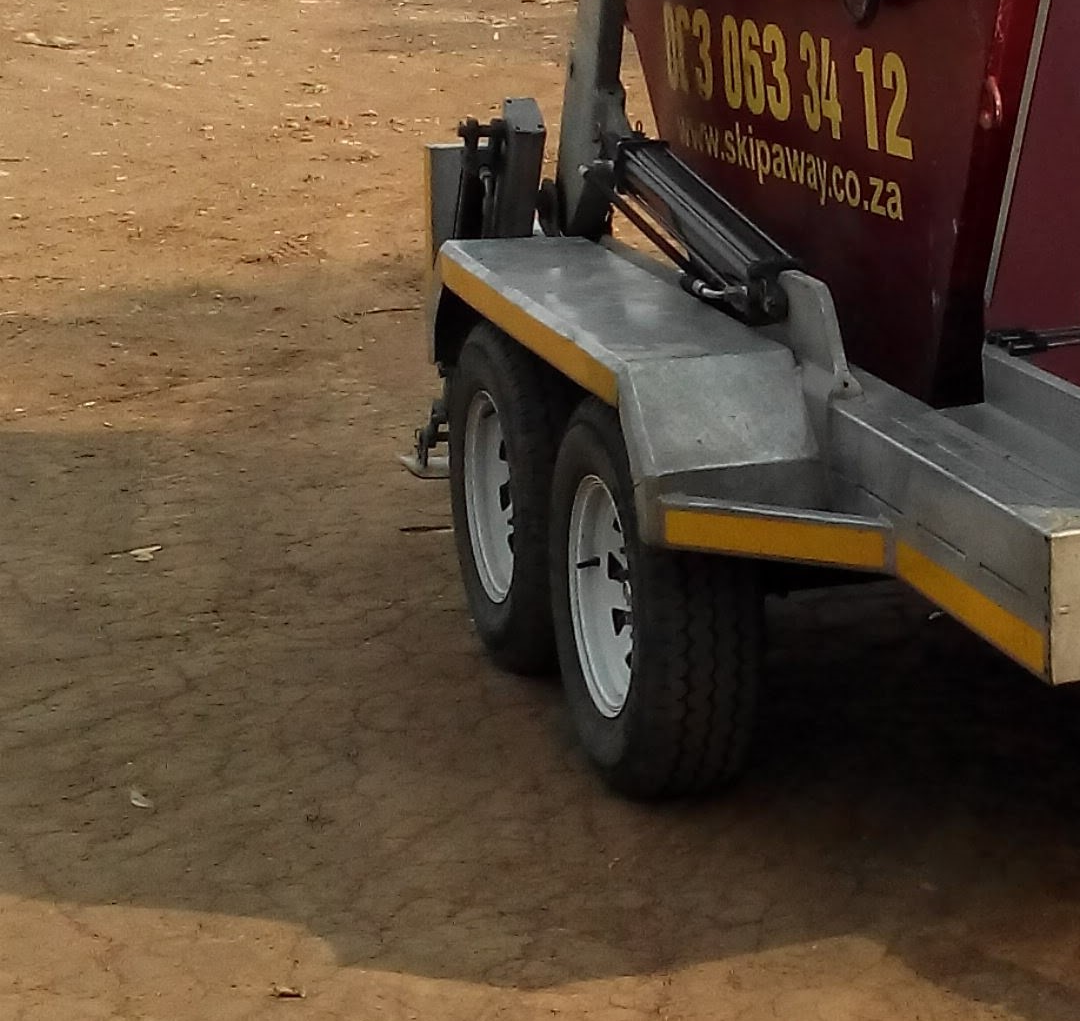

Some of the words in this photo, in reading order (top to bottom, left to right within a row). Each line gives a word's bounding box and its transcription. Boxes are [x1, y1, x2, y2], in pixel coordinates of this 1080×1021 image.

[722, 14, 791, 121] 063
[799, 30, 842, 140] 34
[854, 46, 913, 160] 12
